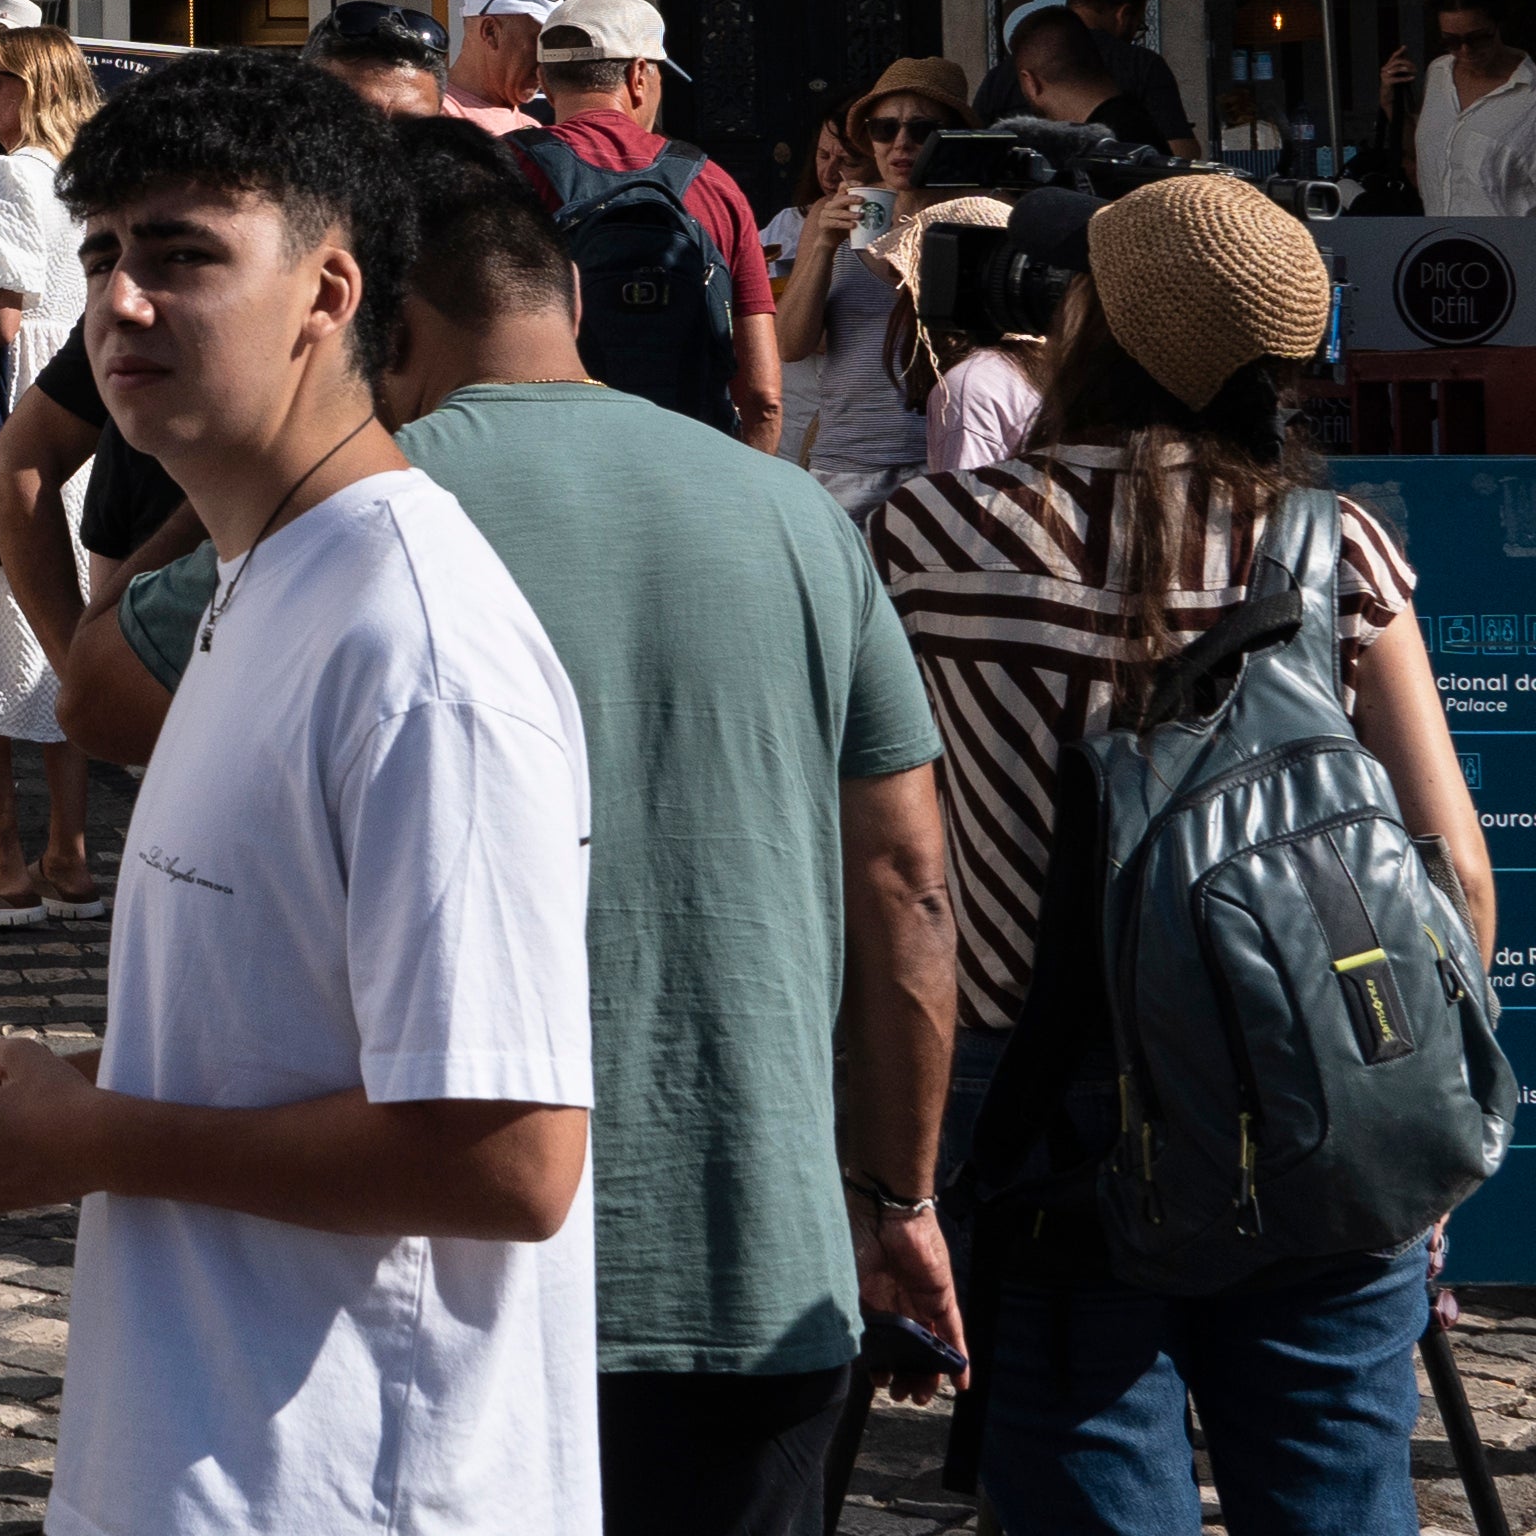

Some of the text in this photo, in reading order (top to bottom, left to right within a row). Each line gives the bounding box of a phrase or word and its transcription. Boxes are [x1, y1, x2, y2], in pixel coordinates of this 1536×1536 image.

[114, 57, 151, 75] CAVES
[1420, 261, 1490, 295] PAÇO
[1431, 295, 1481, 324] REAL
[1436, 672, 1508, 692] cional
[1445, 697, 1508, 713] Palace
[1495, 946, 1524, 965] da
